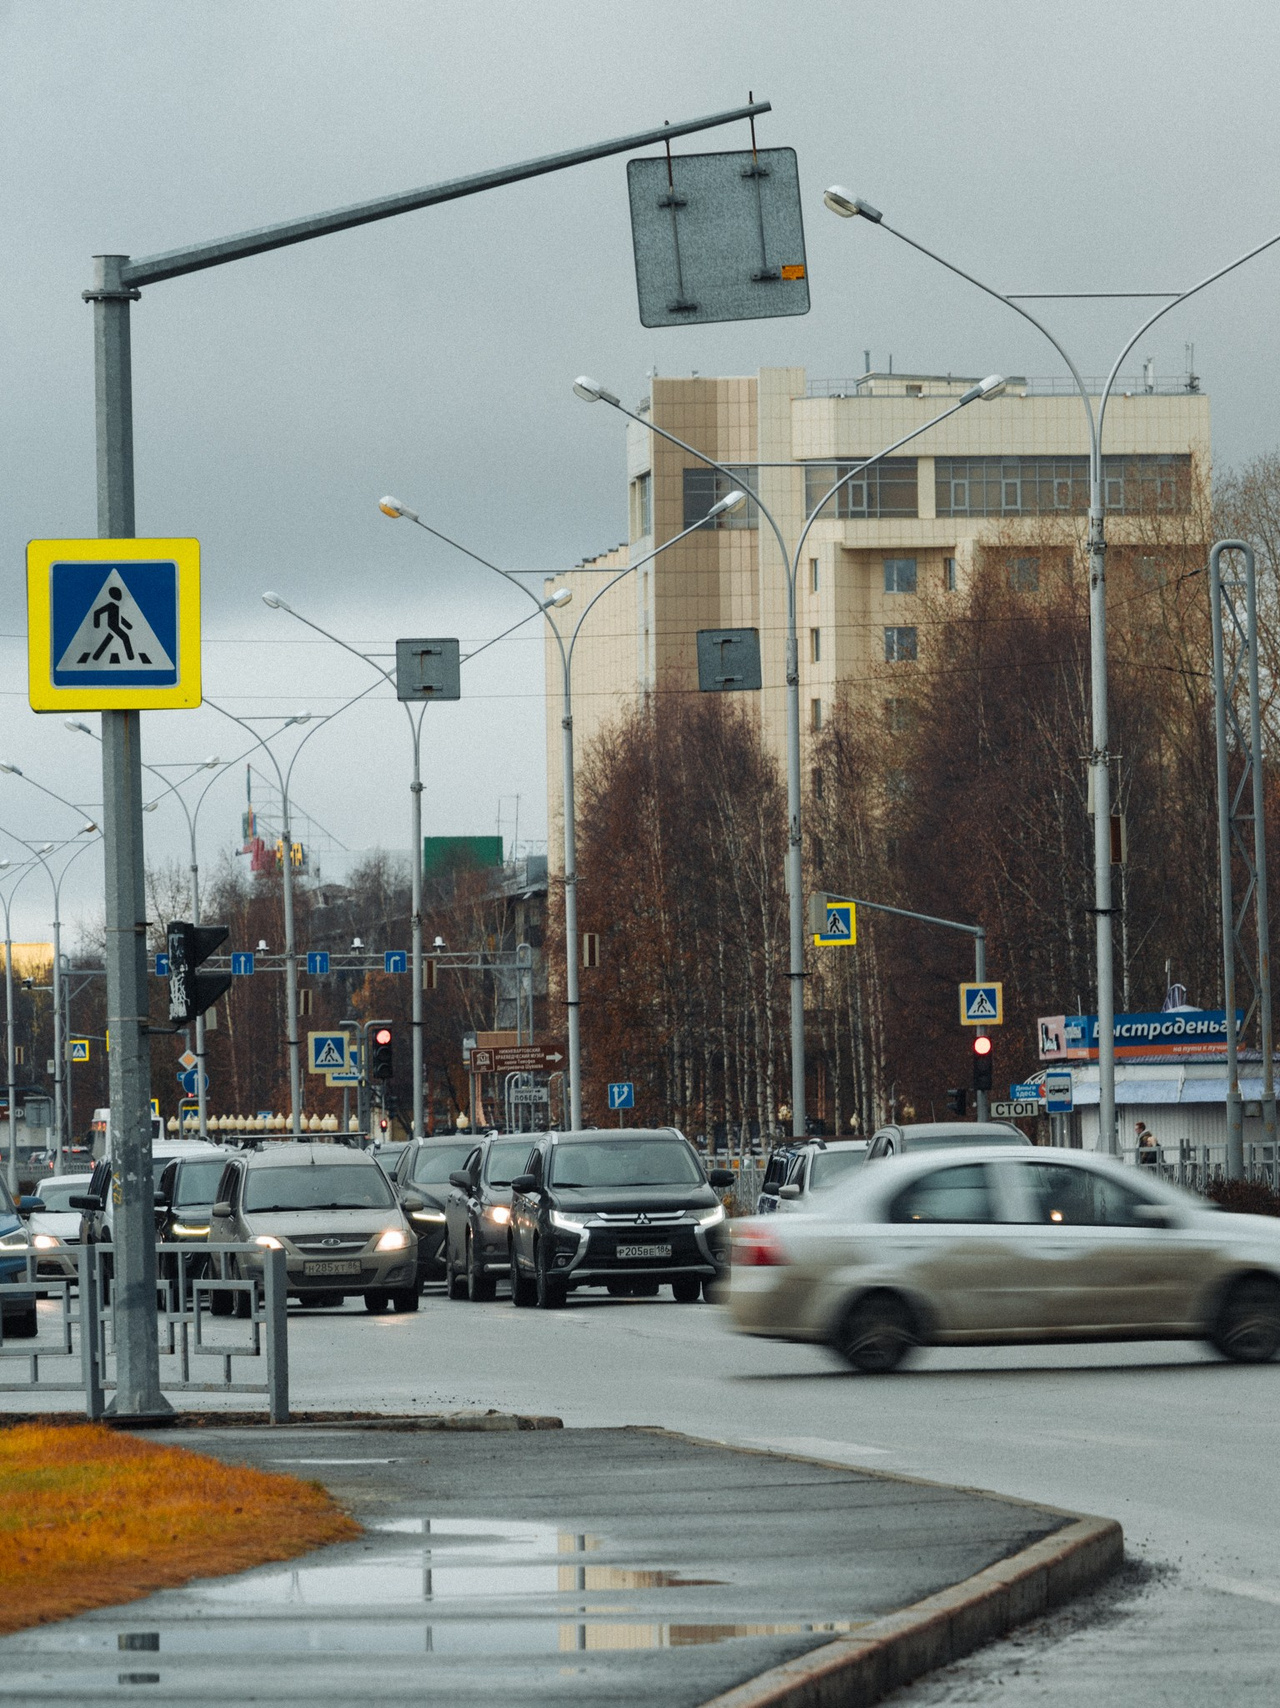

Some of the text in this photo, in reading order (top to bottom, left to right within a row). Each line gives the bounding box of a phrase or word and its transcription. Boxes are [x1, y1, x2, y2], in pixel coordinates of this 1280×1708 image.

[1183, 1045, 1202, 1053] пути
[515, 1094, 543, 1103] ПОБЕДЫ
[995, 1102, 1034, 1116] СТОП
